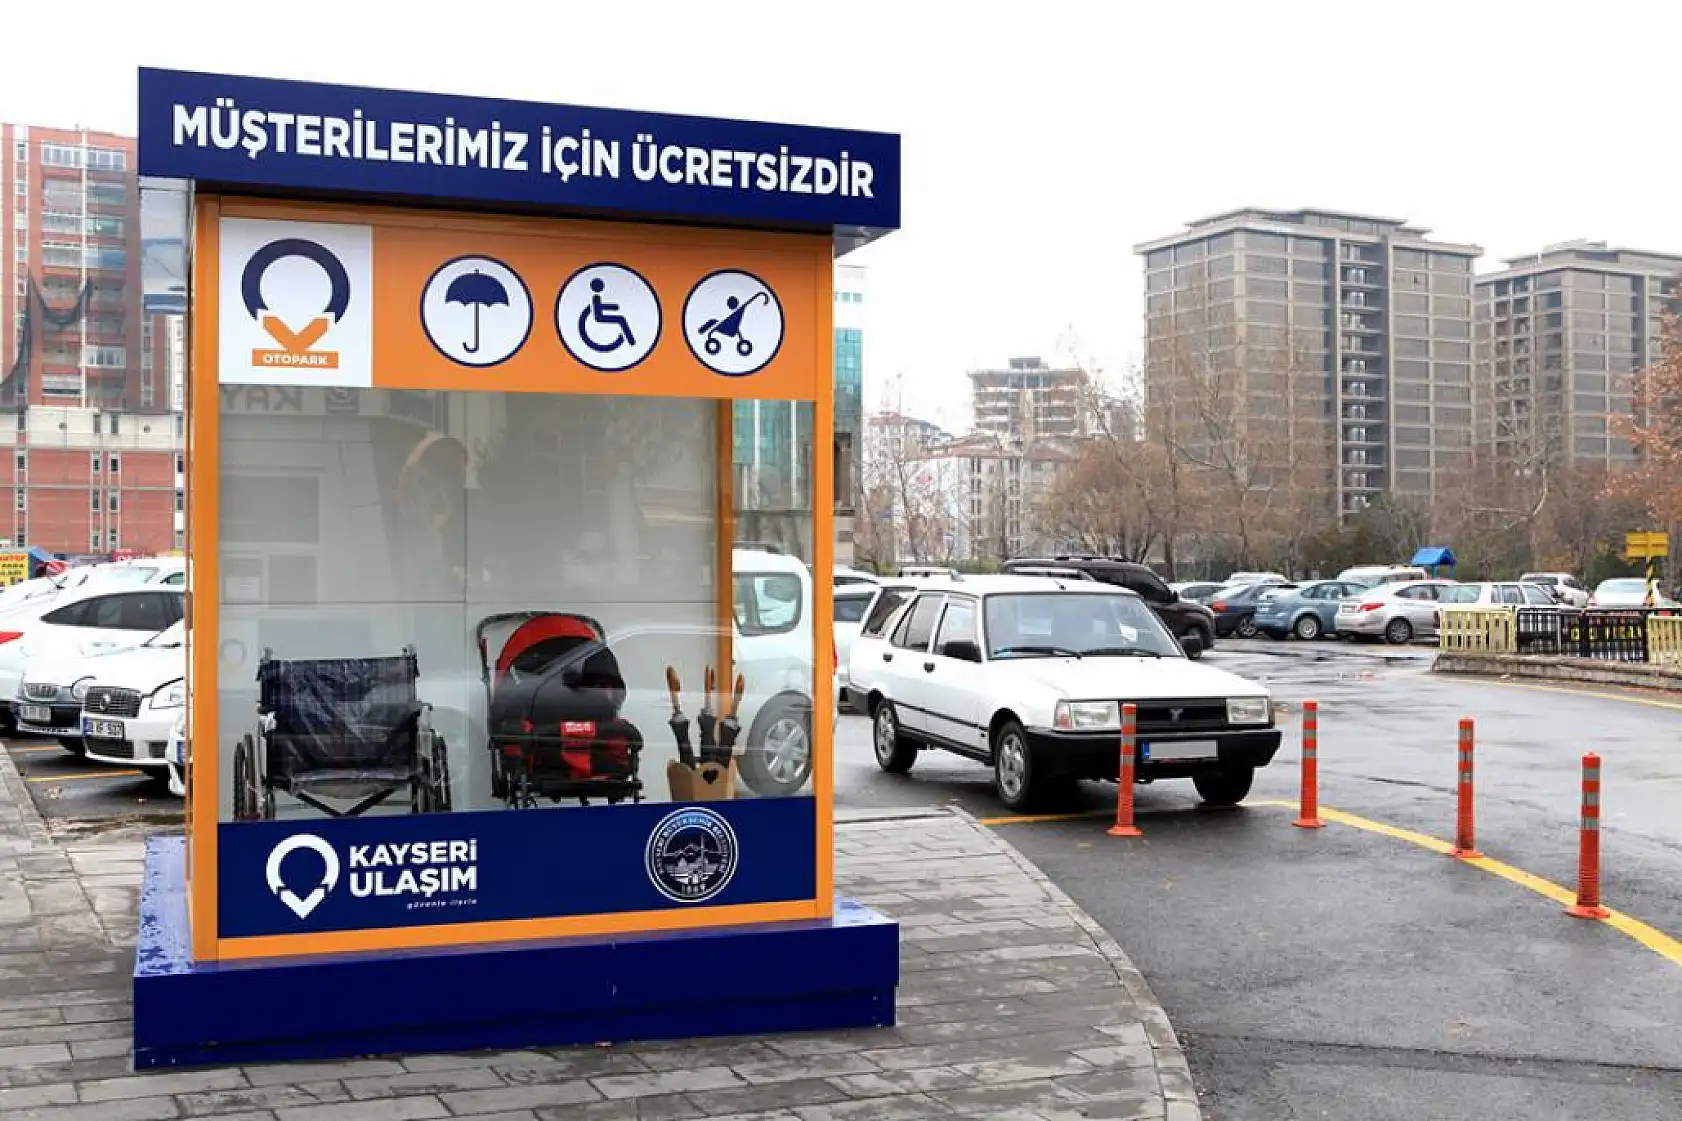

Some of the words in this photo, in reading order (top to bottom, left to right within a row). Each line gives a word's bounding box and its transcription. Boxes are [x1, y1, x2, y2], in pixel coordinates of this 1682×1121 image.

[172, 97, 529, 171] MÜŞTERİLERİMİZ
[541, 125, 621, 183] İÇİN
[631, 133, 875, 198] ÜCRETSİZDİR
[262, 352, 329, 366] OTOPARK
[348, 838, 478, 869] KAYSERİ
[348, 865, 478, 898] ULAŞIM
